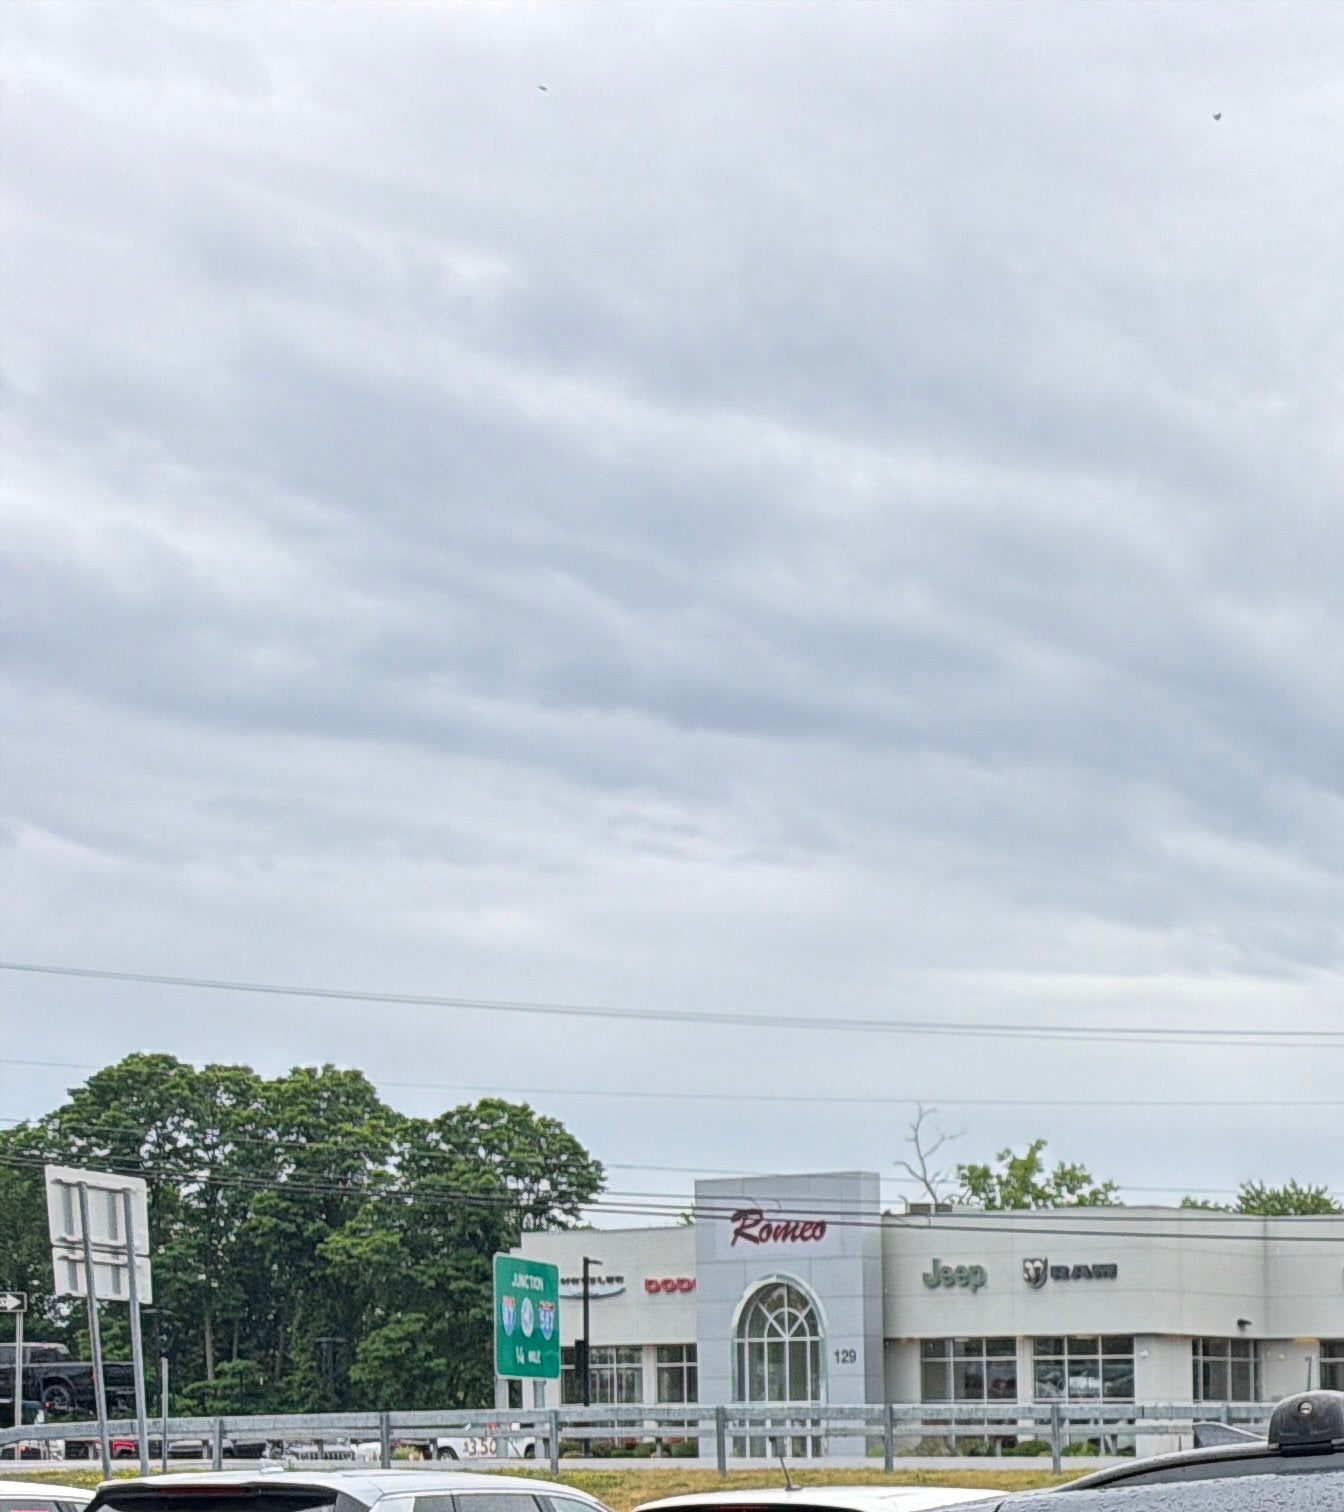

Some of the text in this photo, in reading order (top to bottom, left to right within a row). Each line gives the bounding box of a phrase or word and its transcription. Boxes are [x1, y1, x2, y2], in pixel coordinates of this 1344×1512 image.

[730, 1208, 827, 1247] Romeo
[922, 1257, 987, 1294] Jeep
[1050, 1263, 1118, 1280] RAM
[644, 1278, 697, 1294] DOD
[834, 1349, 857, 1364] 129
